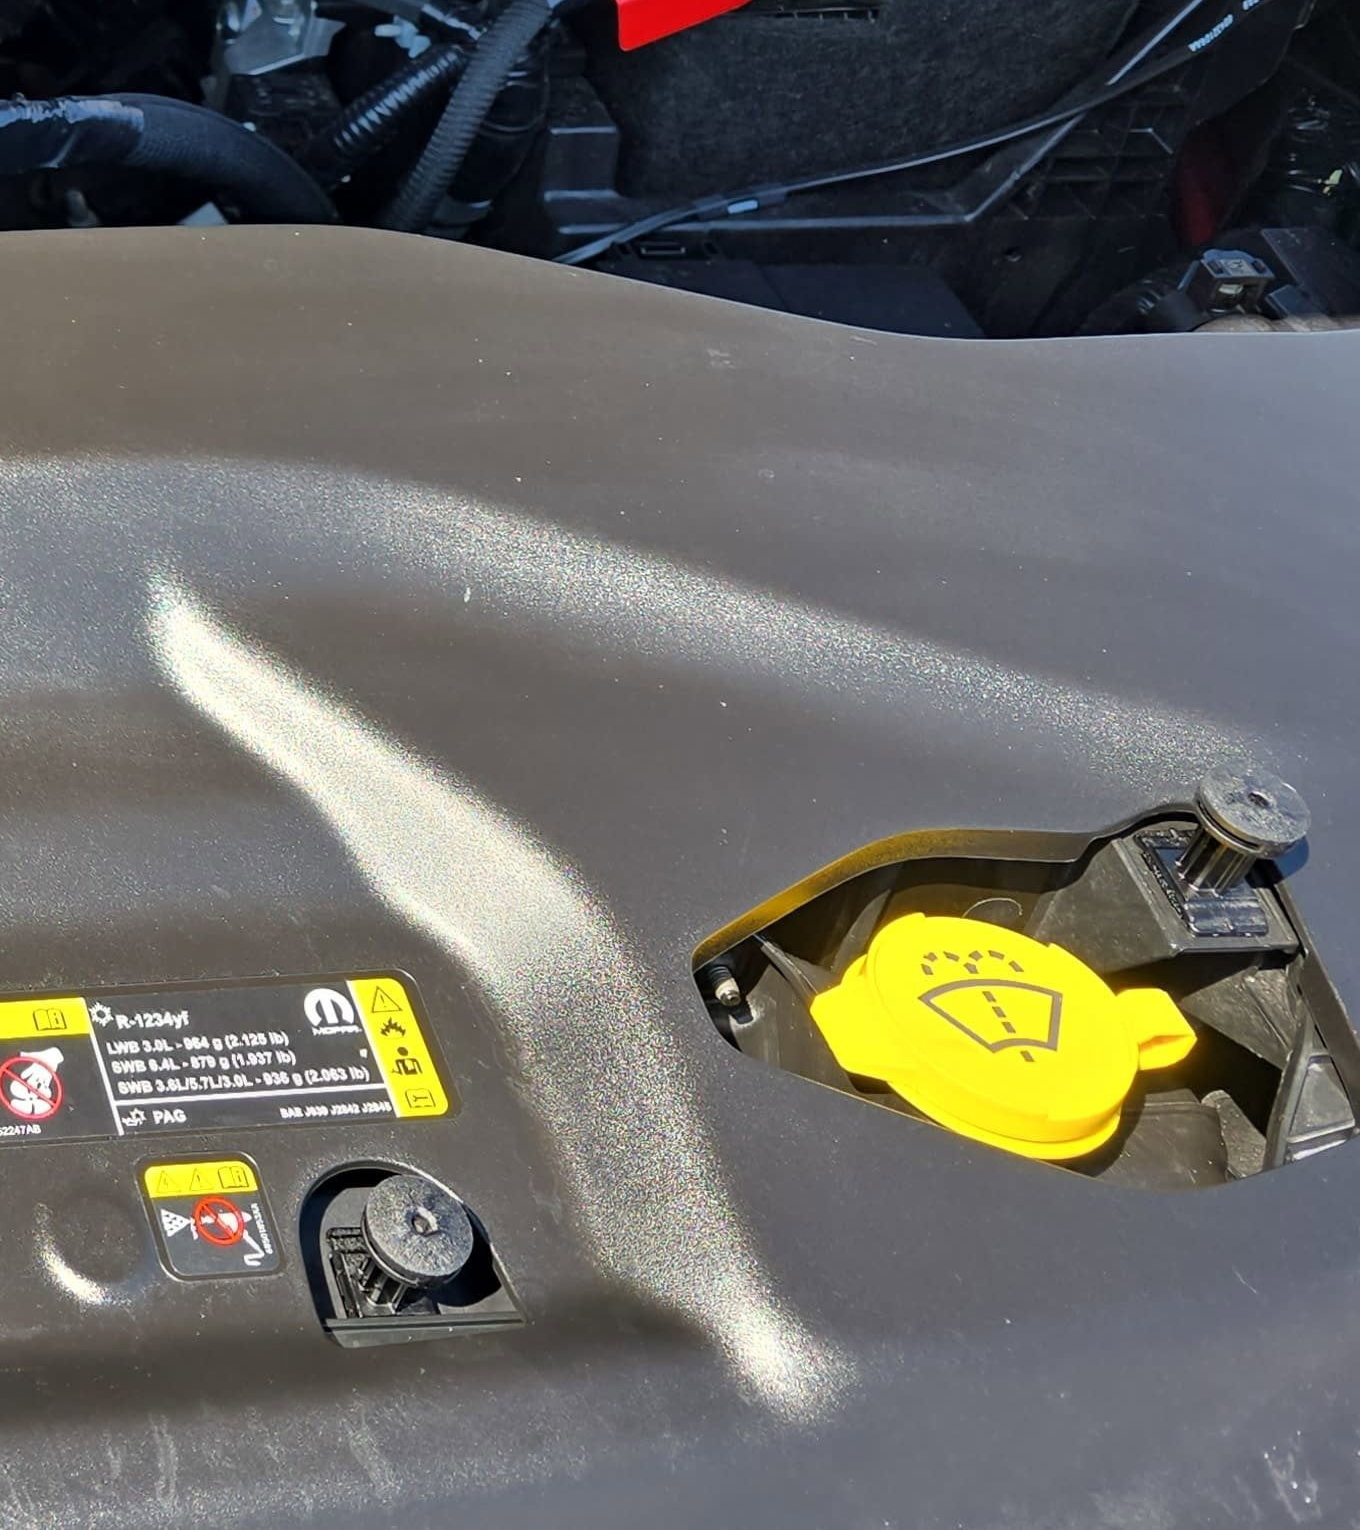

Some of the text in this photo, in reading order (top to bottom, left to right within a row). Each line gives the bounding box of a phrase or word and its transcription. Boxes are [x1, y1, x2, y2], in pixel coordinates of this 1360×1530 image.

[115, 1010, 190, 1029] R-1234yf
[106, 1040, 140, 1055] LWB
[142, 1038, 174, 1053] 3.0L
[224, 1032, 268, 1050] (2.125
[268, 1030, 290, 1047] lb)
[111, 1059, 147, 1075] SWB
[231, 1051, 273, 1069] (1.937
[274, 1049, 297, 1066] lb)
[117, 1080, 153, 1095] SWB
[348, 1065, 371, 1082] lb)
[152, 1109, 187, 1125] PAG
